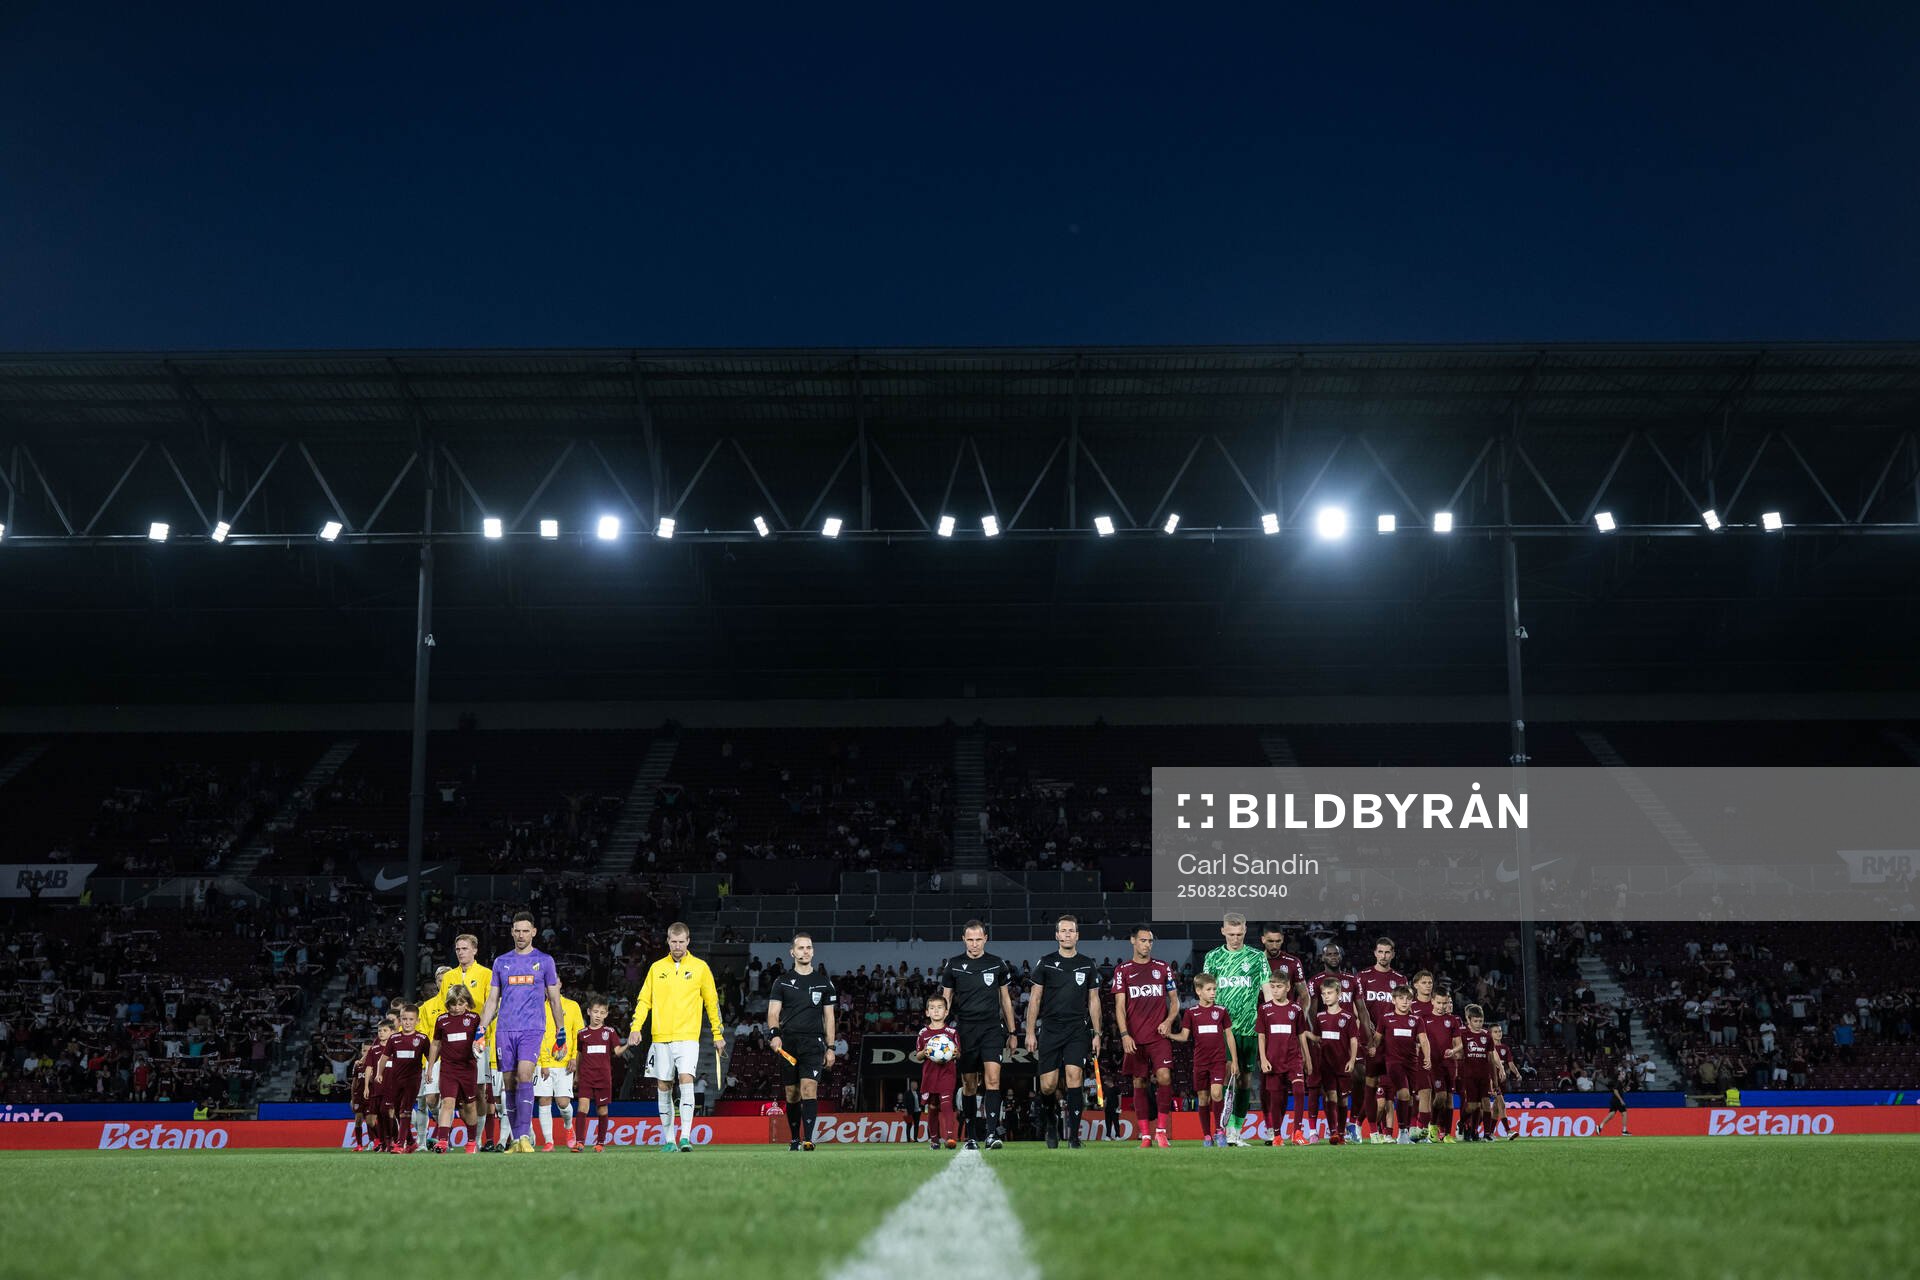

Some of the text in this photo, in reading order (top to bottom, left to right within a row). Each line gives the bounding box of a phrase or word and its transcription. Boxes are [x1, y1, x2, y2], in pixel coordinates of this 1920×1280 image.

[1862, 855, 1911, 875] RMB
[16, 870, 68, 889] RMB
[1128, 983, 1163, 999] DON
[1219, 975, 1252, 988] DON
[648, 1054, 655, 1068] 4
[1478, 1111, 1596, 1137] etano
[1708, 1109, 1835, 1136] Betano
[98, 1123, 229, 1150] Betano
